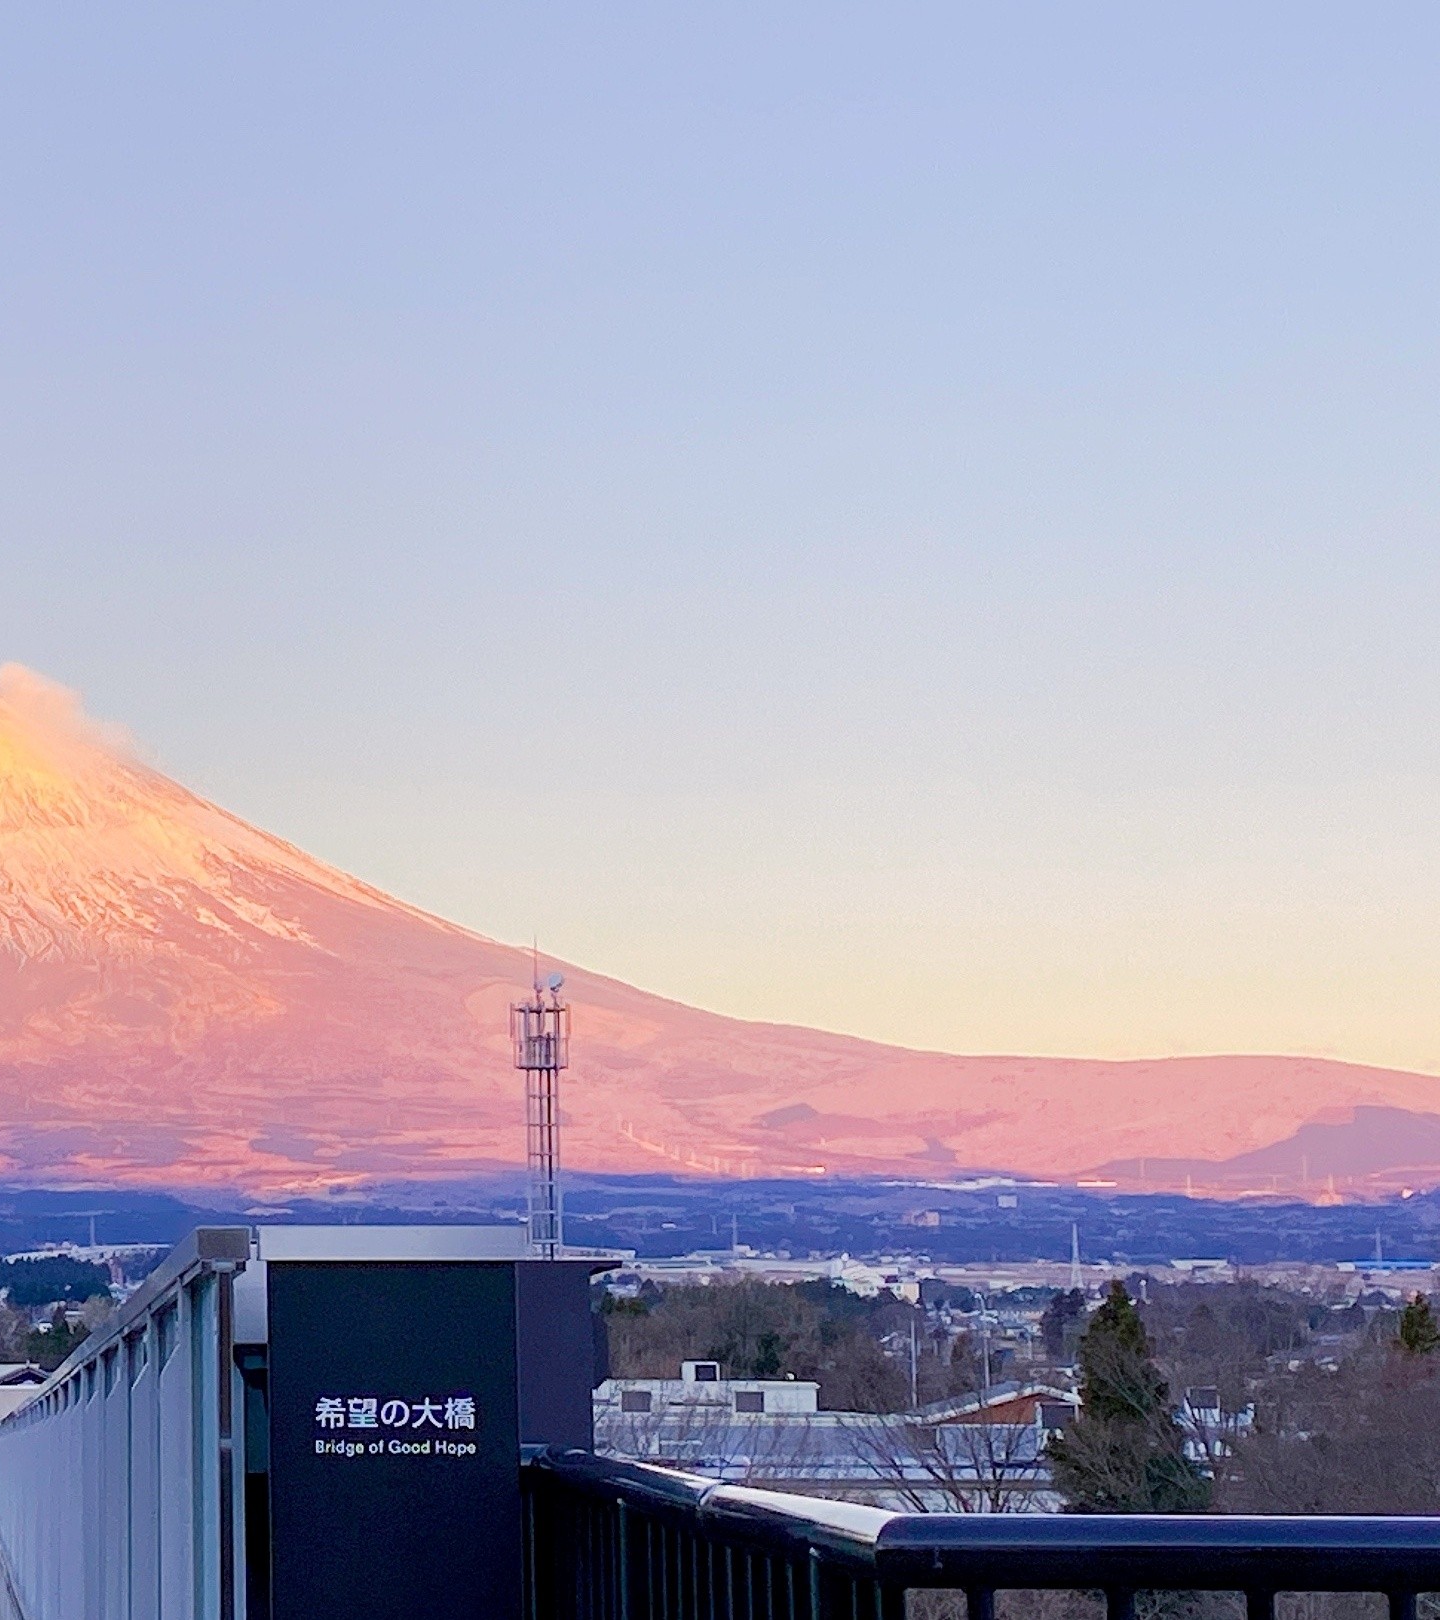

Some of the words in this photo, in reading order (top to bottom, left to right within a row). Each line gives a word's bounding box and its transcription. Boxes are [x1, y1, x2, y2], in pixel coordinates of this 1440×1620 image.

[315, 1397, 476, 1429] 希望の大橋
[315, 1439, 365, 1457] Bridge
[368, 1439, 385, 1454] of
[388, 1439, 431, 1454] Good
[435, 1440, 477, 1457] Hope
